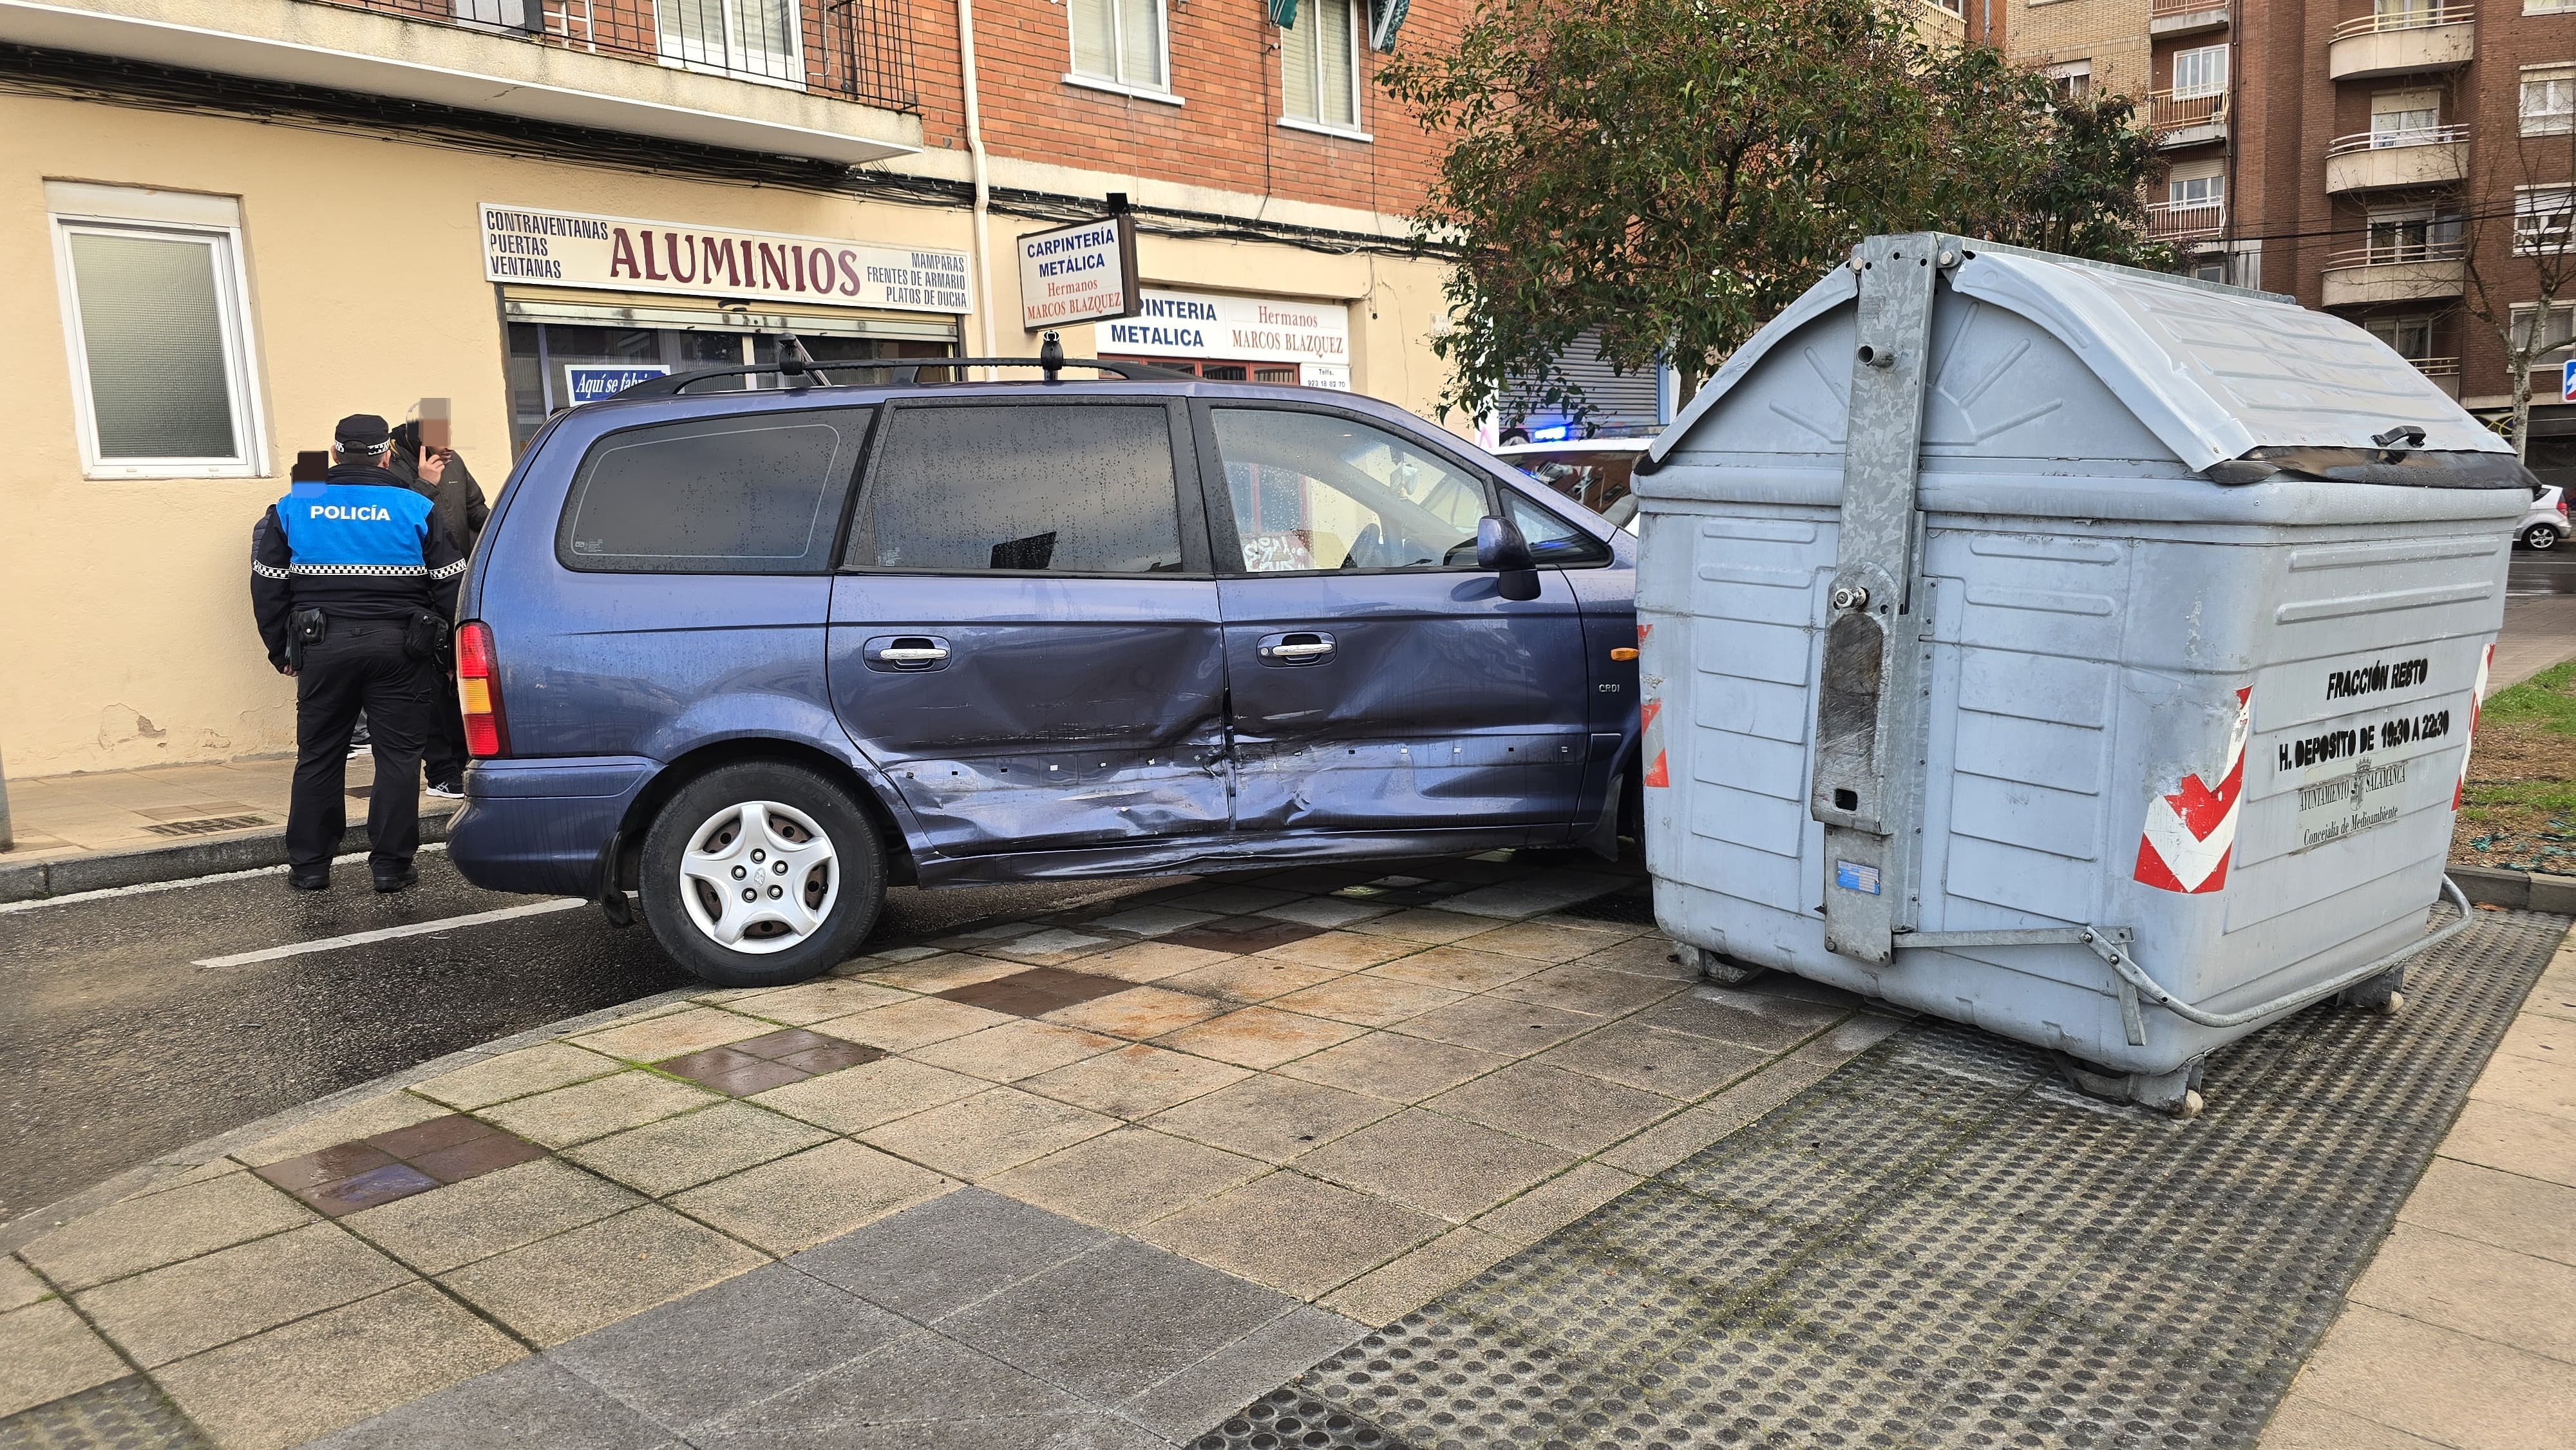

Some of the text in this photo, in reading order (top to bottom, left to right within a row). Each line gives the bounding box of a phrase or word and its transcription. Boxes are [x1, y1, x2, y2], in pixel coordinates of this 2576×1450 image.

[486, 211, 609, 240] CONTRAVENTANAS
[490, 233, 548, 256] PUERTAS
[1027, 226, 1115, 258] CARPINTERÍA
[490, 256, 562, 279] VENTANAS
[610, 227, 861, 296] ALUMINIOS
[911, 252, 964, 273] MAMPARAS
[1039, 253, 1105, 278] METÁLICA
[867, 266, 965, 290] FRENTES DE ARMARIO
[1047, 279, 1098, 297] Hermanos
[886, 286, 967, 308] PLATOS DE DUCHA
[1027, 292, 1122, 320] MARCOS BLAZQUEZ
[1258, 305, 1318, 328] Hermanos
[1111, 324, 1204, 347] METALICA
[1232, 329, 1344, 359] MARCOS BLAZQUEZ
[575, 373, 607, 399] Aquí
[605, 380, 618, 393] se
[310, 504, 390, 521] POLICÍA
[2326, 658, 2428, 701] FRACCIÓN RESTO
[2279, 744, 2292, 771] H.
[2295, 730, 2356, 768] DEPOSITO
[2360, 725, 2375, 754] DE
[2412, 717, 2420, 742] A
[2421, 710, 2449, 740] 22:30
[2298, 764, 2407, 812] AYUNTAMIENTO SALAMANCA
[2304, 805, 2398, 846] Concejalía de Medioambiente
